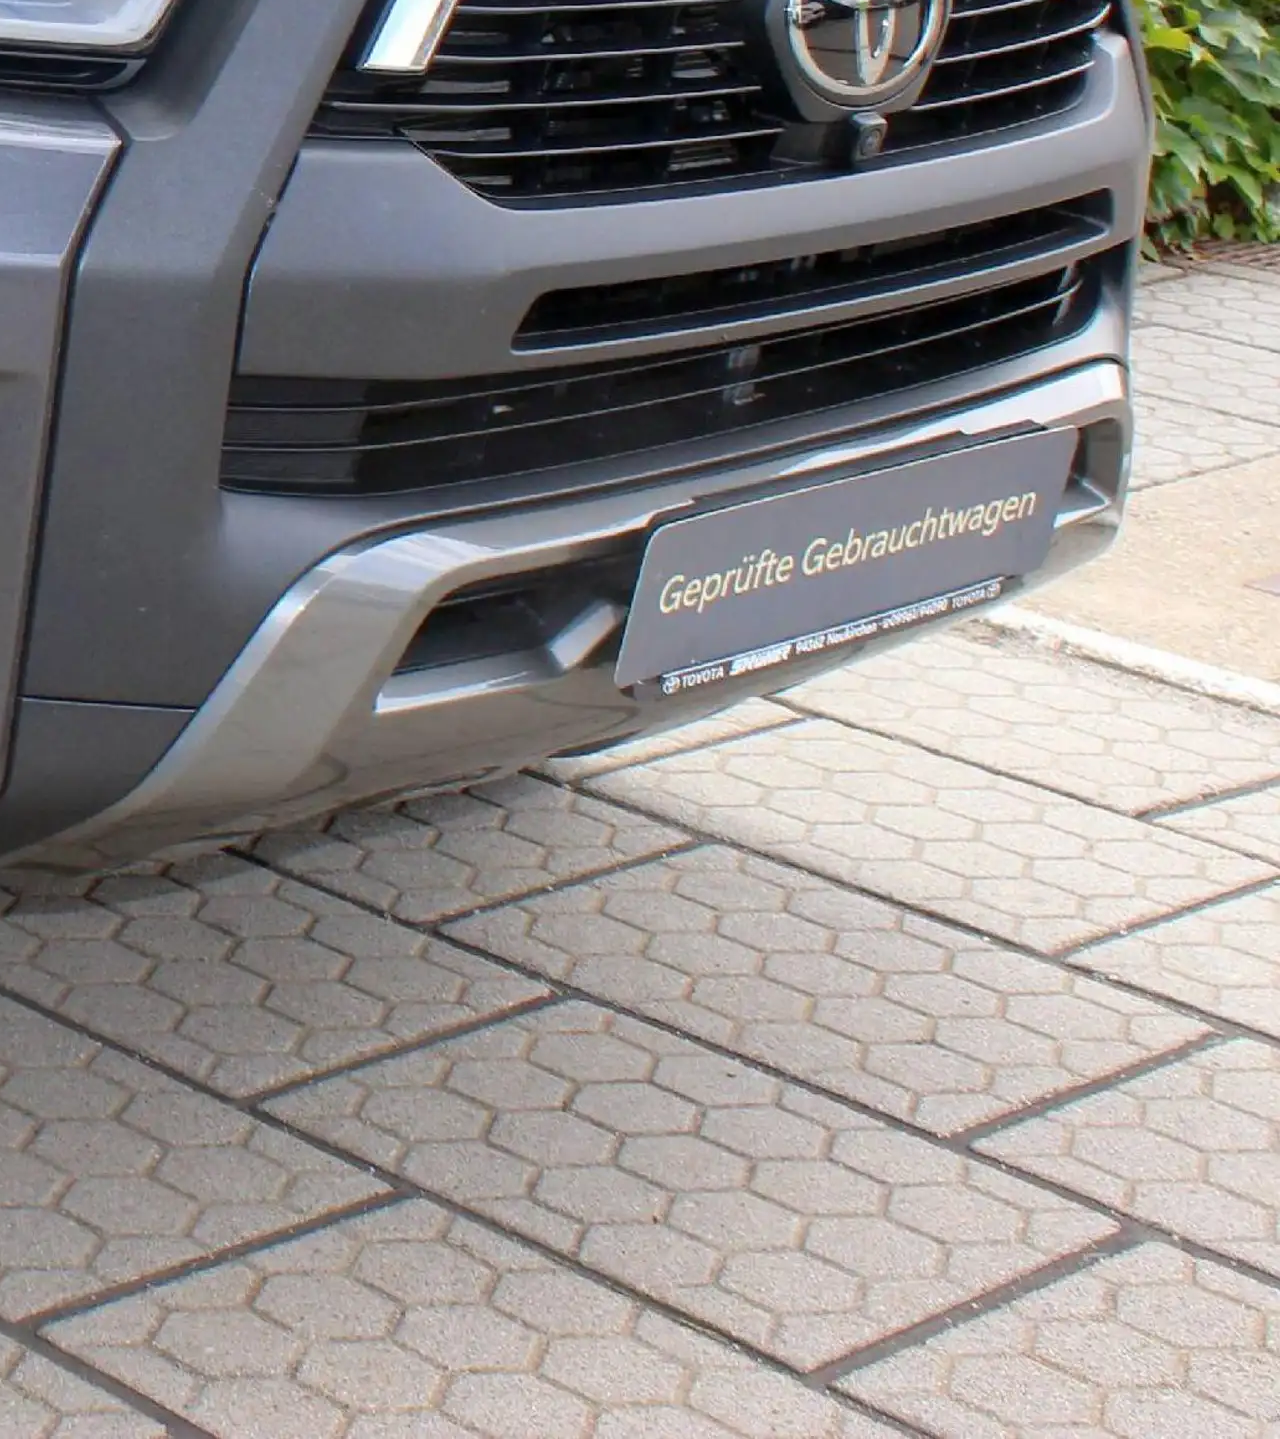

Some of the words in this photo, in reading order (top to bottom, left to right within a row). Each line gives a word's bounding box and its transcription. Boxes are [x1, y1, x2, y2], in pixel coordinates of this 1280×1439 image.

[659, 549, 794, 615] Geprüfte
[800, 489, 1037, 578] Gebrauchtwagen
[682, 665, 724, 689] TOYOTA
